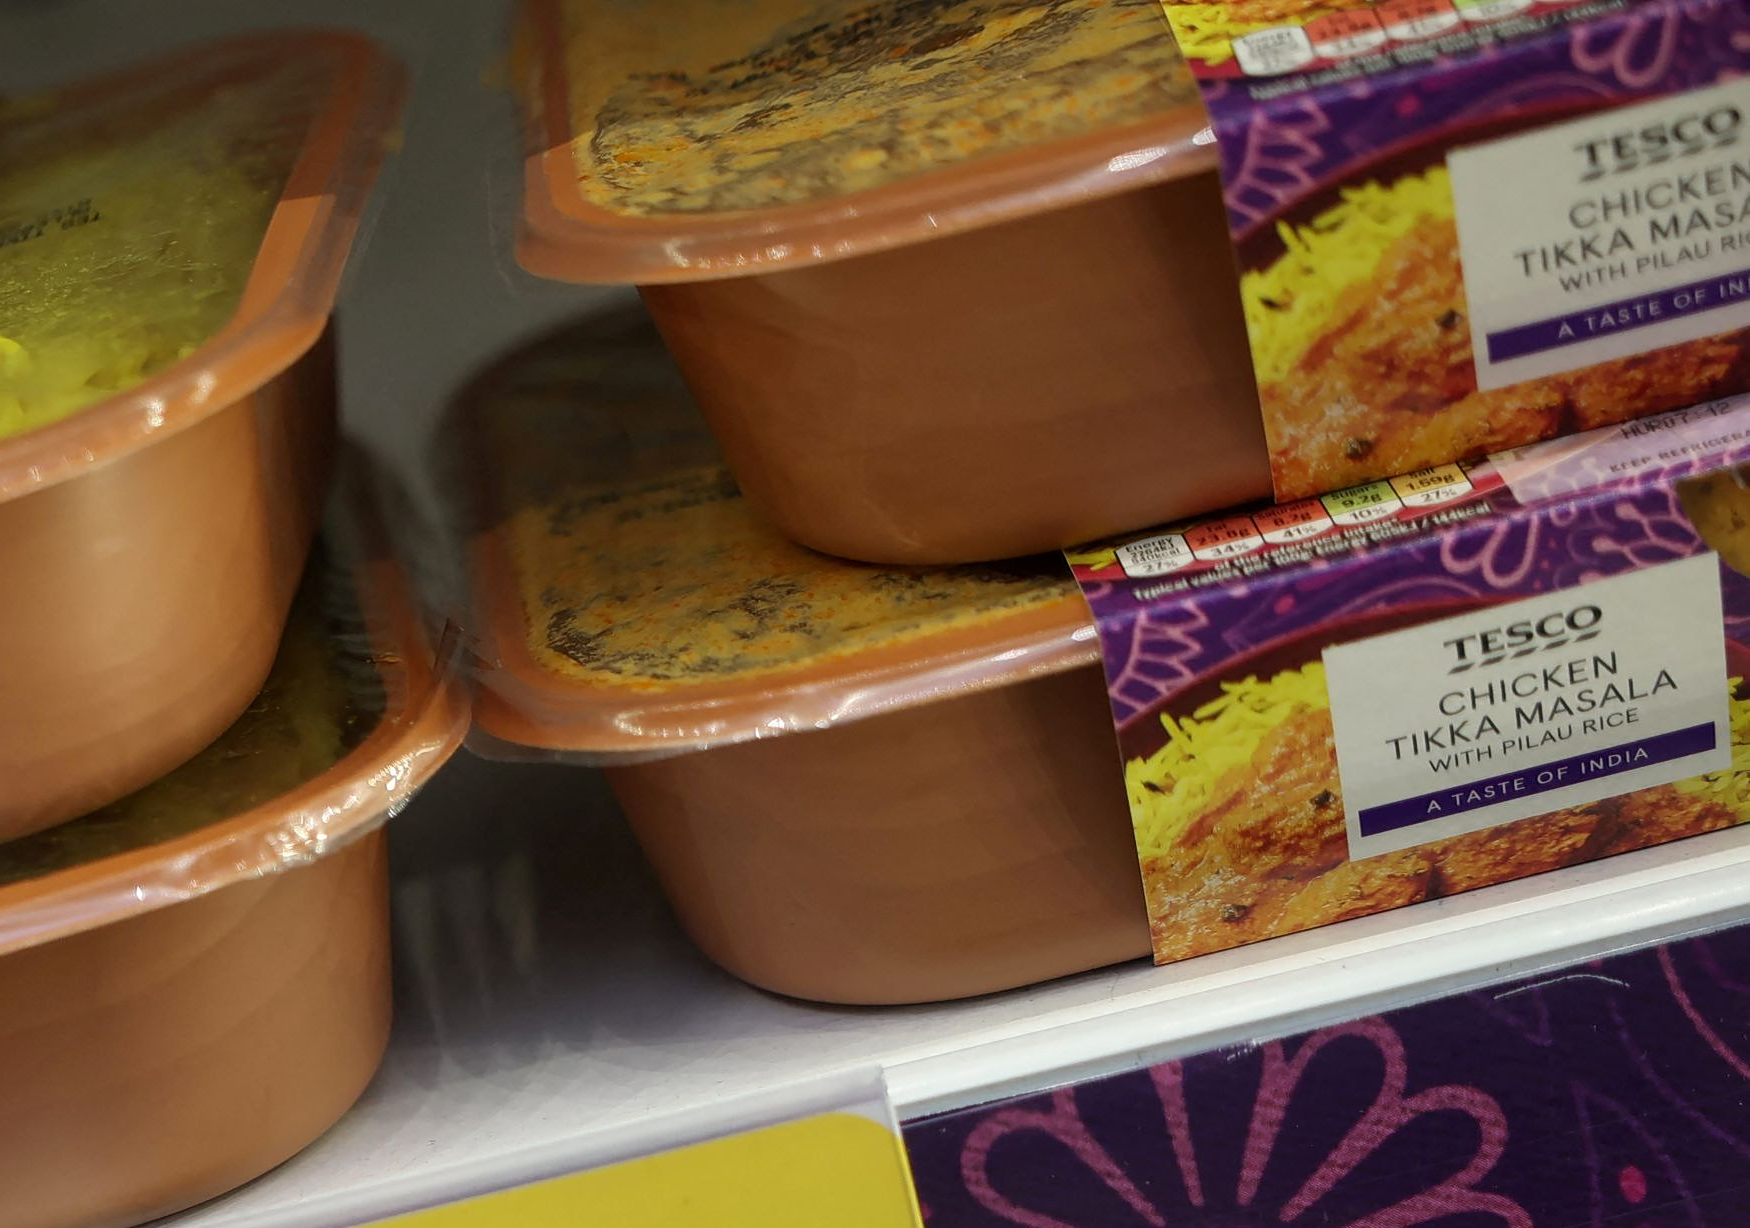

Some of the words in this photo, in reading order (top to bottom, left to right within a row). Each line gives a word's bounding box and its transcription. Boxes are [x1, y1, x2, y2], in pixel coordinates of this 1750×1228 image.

[1573, 106, 1741, 168] TESCO
[1514, 227, 1636, 278] TIKKA
[1559, 261, 1628, 293] WITH
[1636, 240, 1711, 275] PILAU
[1558, 320, 1576, 339] A
[1584, 301, 1662, 332] TASTE
[1673, 287, 1708, 309] OF
[1718, 277, 1750, 298] IN
[1610, 456, 1652, 473] KEEP
[1124, 536, 1173, 552] Energy
[1132, 578, 1189, 600] Typical
[1443, 604, 1603, 662] TESCO
[1438, 651, 1618, 716] CHICKEN
[1385, 714, 1501, 760] TIKKA
[1515, 669, 1678, 730] MASALA
[1429, 745, 1493, 774] WITH
[1502, 725, 1573, 757] PILAU
[1582, 707, 1641, 736] RICE
[1426, 799, 1442, 814] A
[1451, 780, 1526, 806] TASTE
[1537, 765, 1569, 785] OF
[1581, 747, 1649, 775] INDIA
